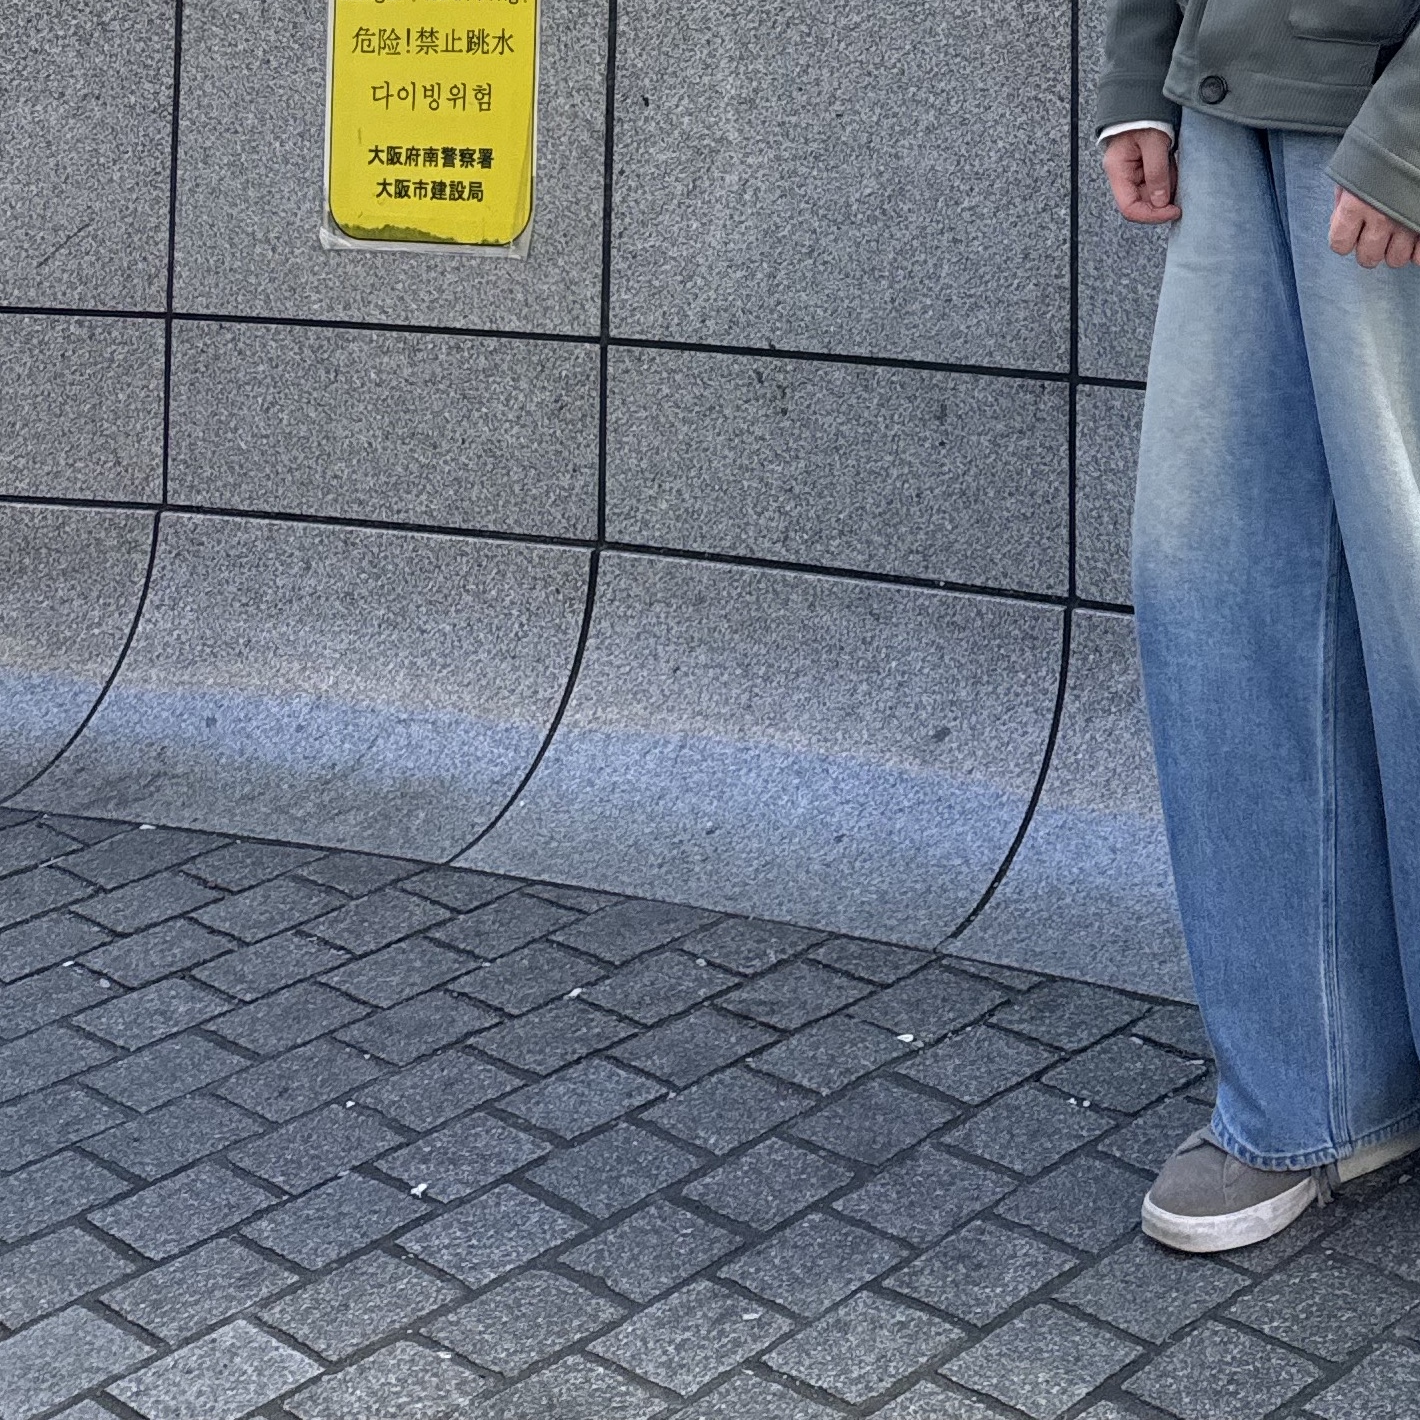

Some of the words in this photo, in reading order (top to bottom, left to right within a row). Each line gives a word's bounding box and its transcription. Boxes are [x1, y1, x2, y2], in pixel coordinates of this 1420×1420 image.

[367, 145, 495, 169] 大阪府南警察署
[375, 177, 485, 202] 大阪市建設局
